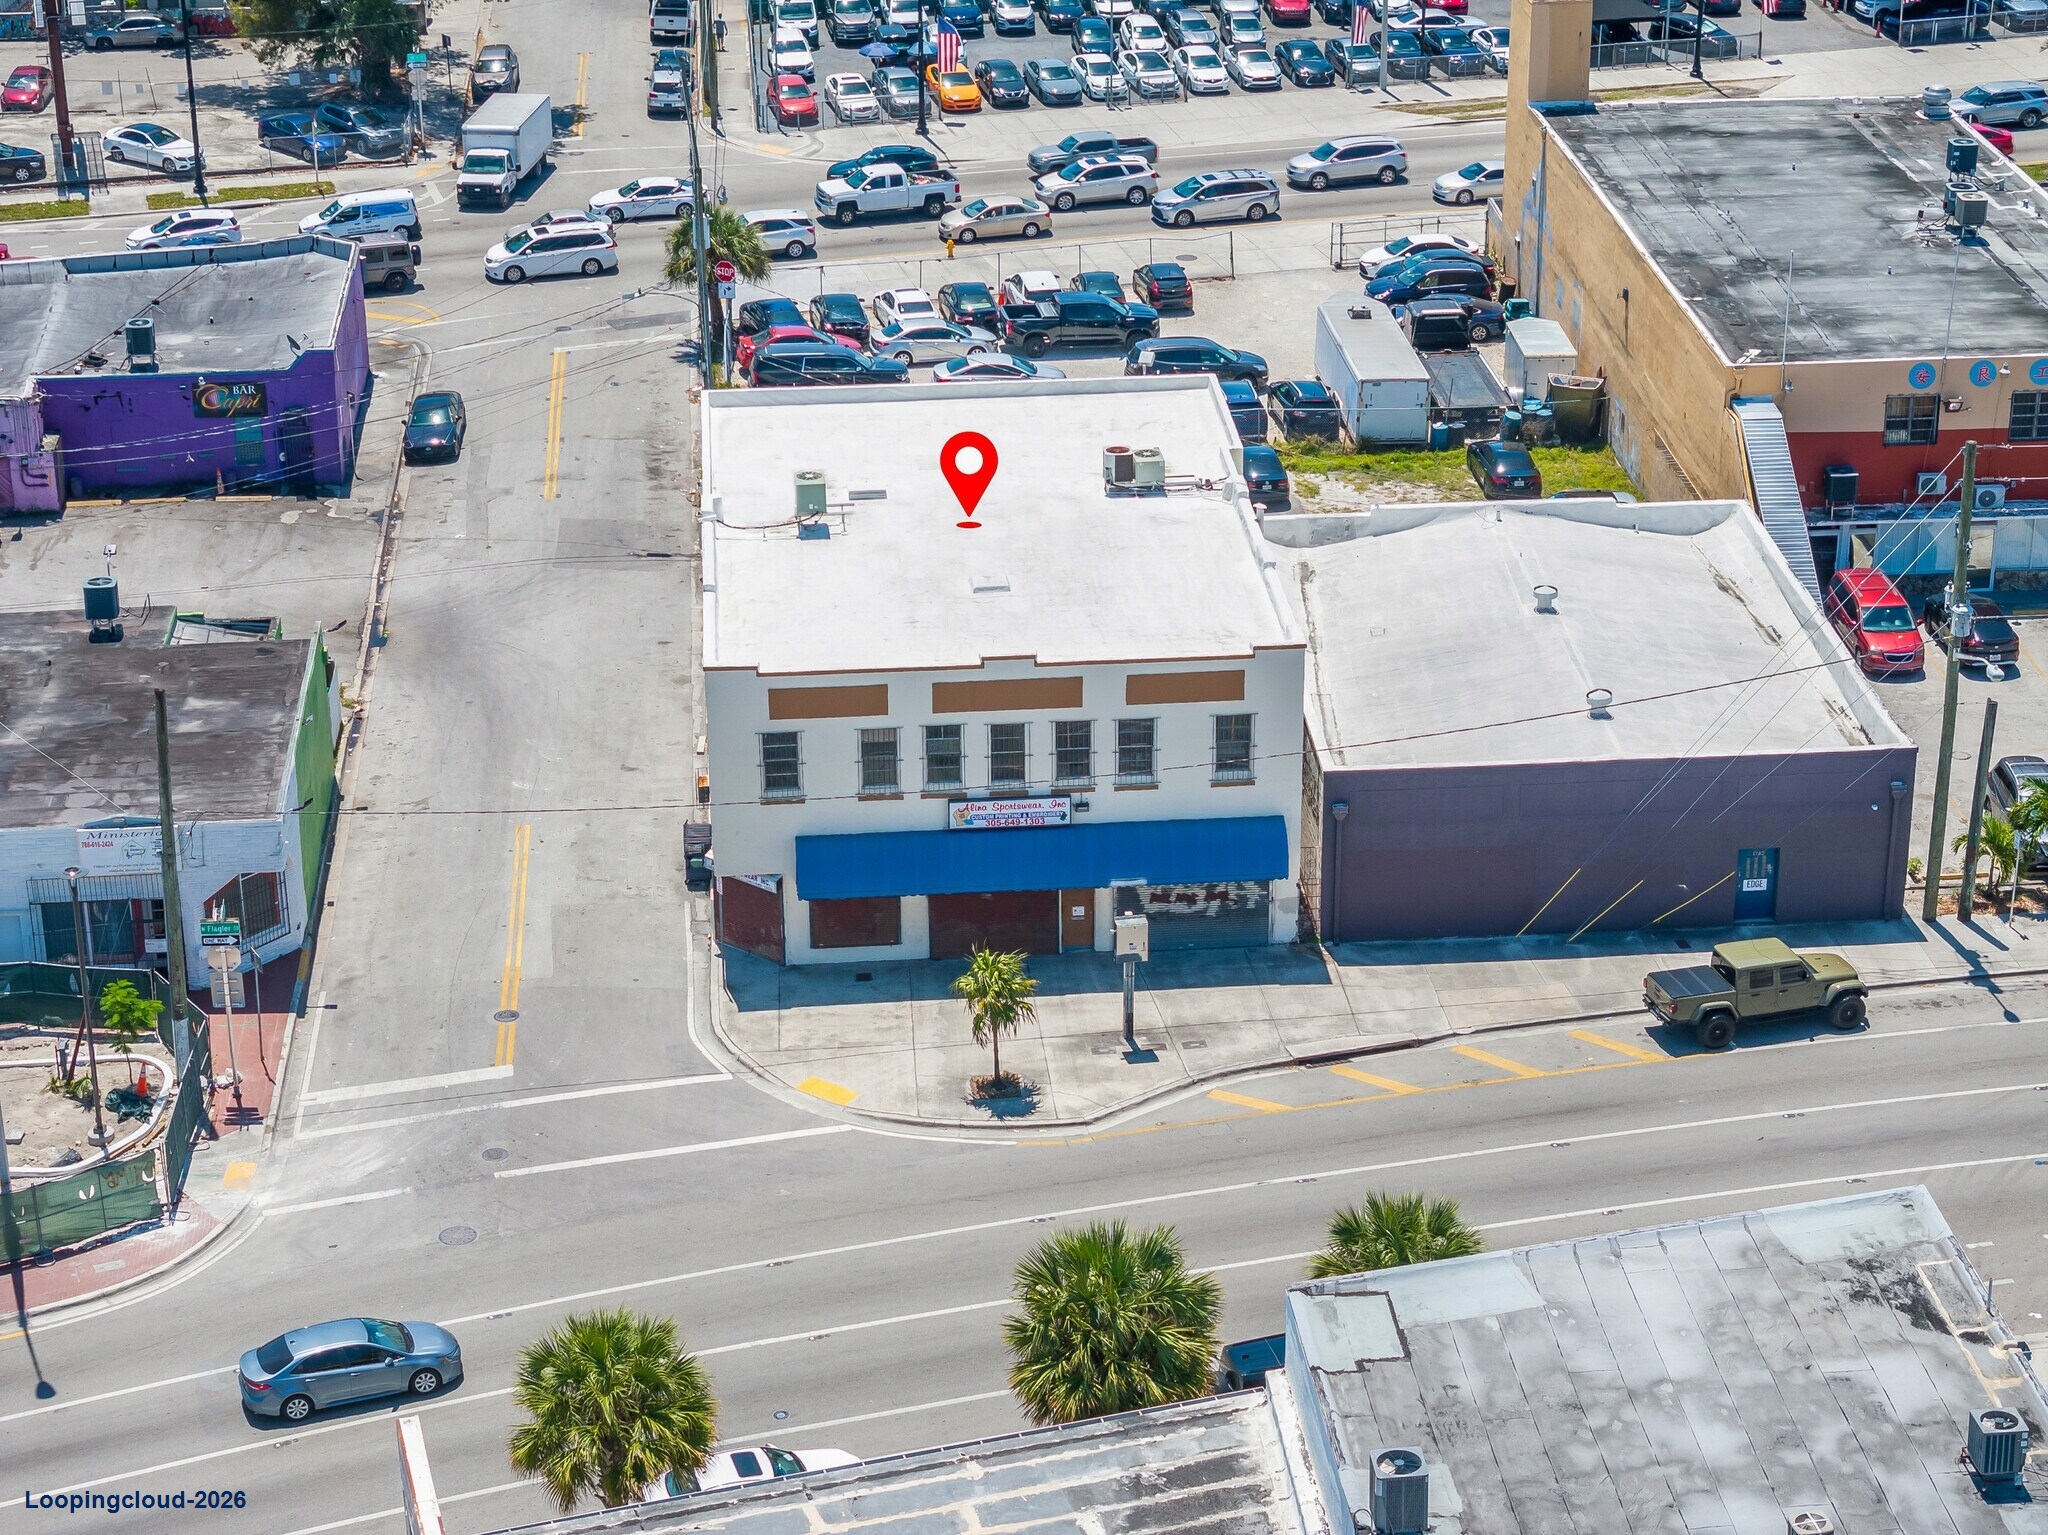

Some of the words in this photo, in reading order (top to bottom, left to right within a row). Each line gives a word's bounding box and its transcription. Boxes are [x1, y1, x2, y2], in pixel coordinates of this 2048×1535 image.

[716, 267, 734, 276] STOP
[233, 385, 256, 395] BAR
[196, 384, 261, 417] Capri
[963, 803, 987, 813] Alina
[1048, 799, 1067, 809] Inc
[985, 817, 1046, 827] 305-649-1303
[1746, 880, 1763, 888] EDGE
[207, 925, 231, 934] Flagler
